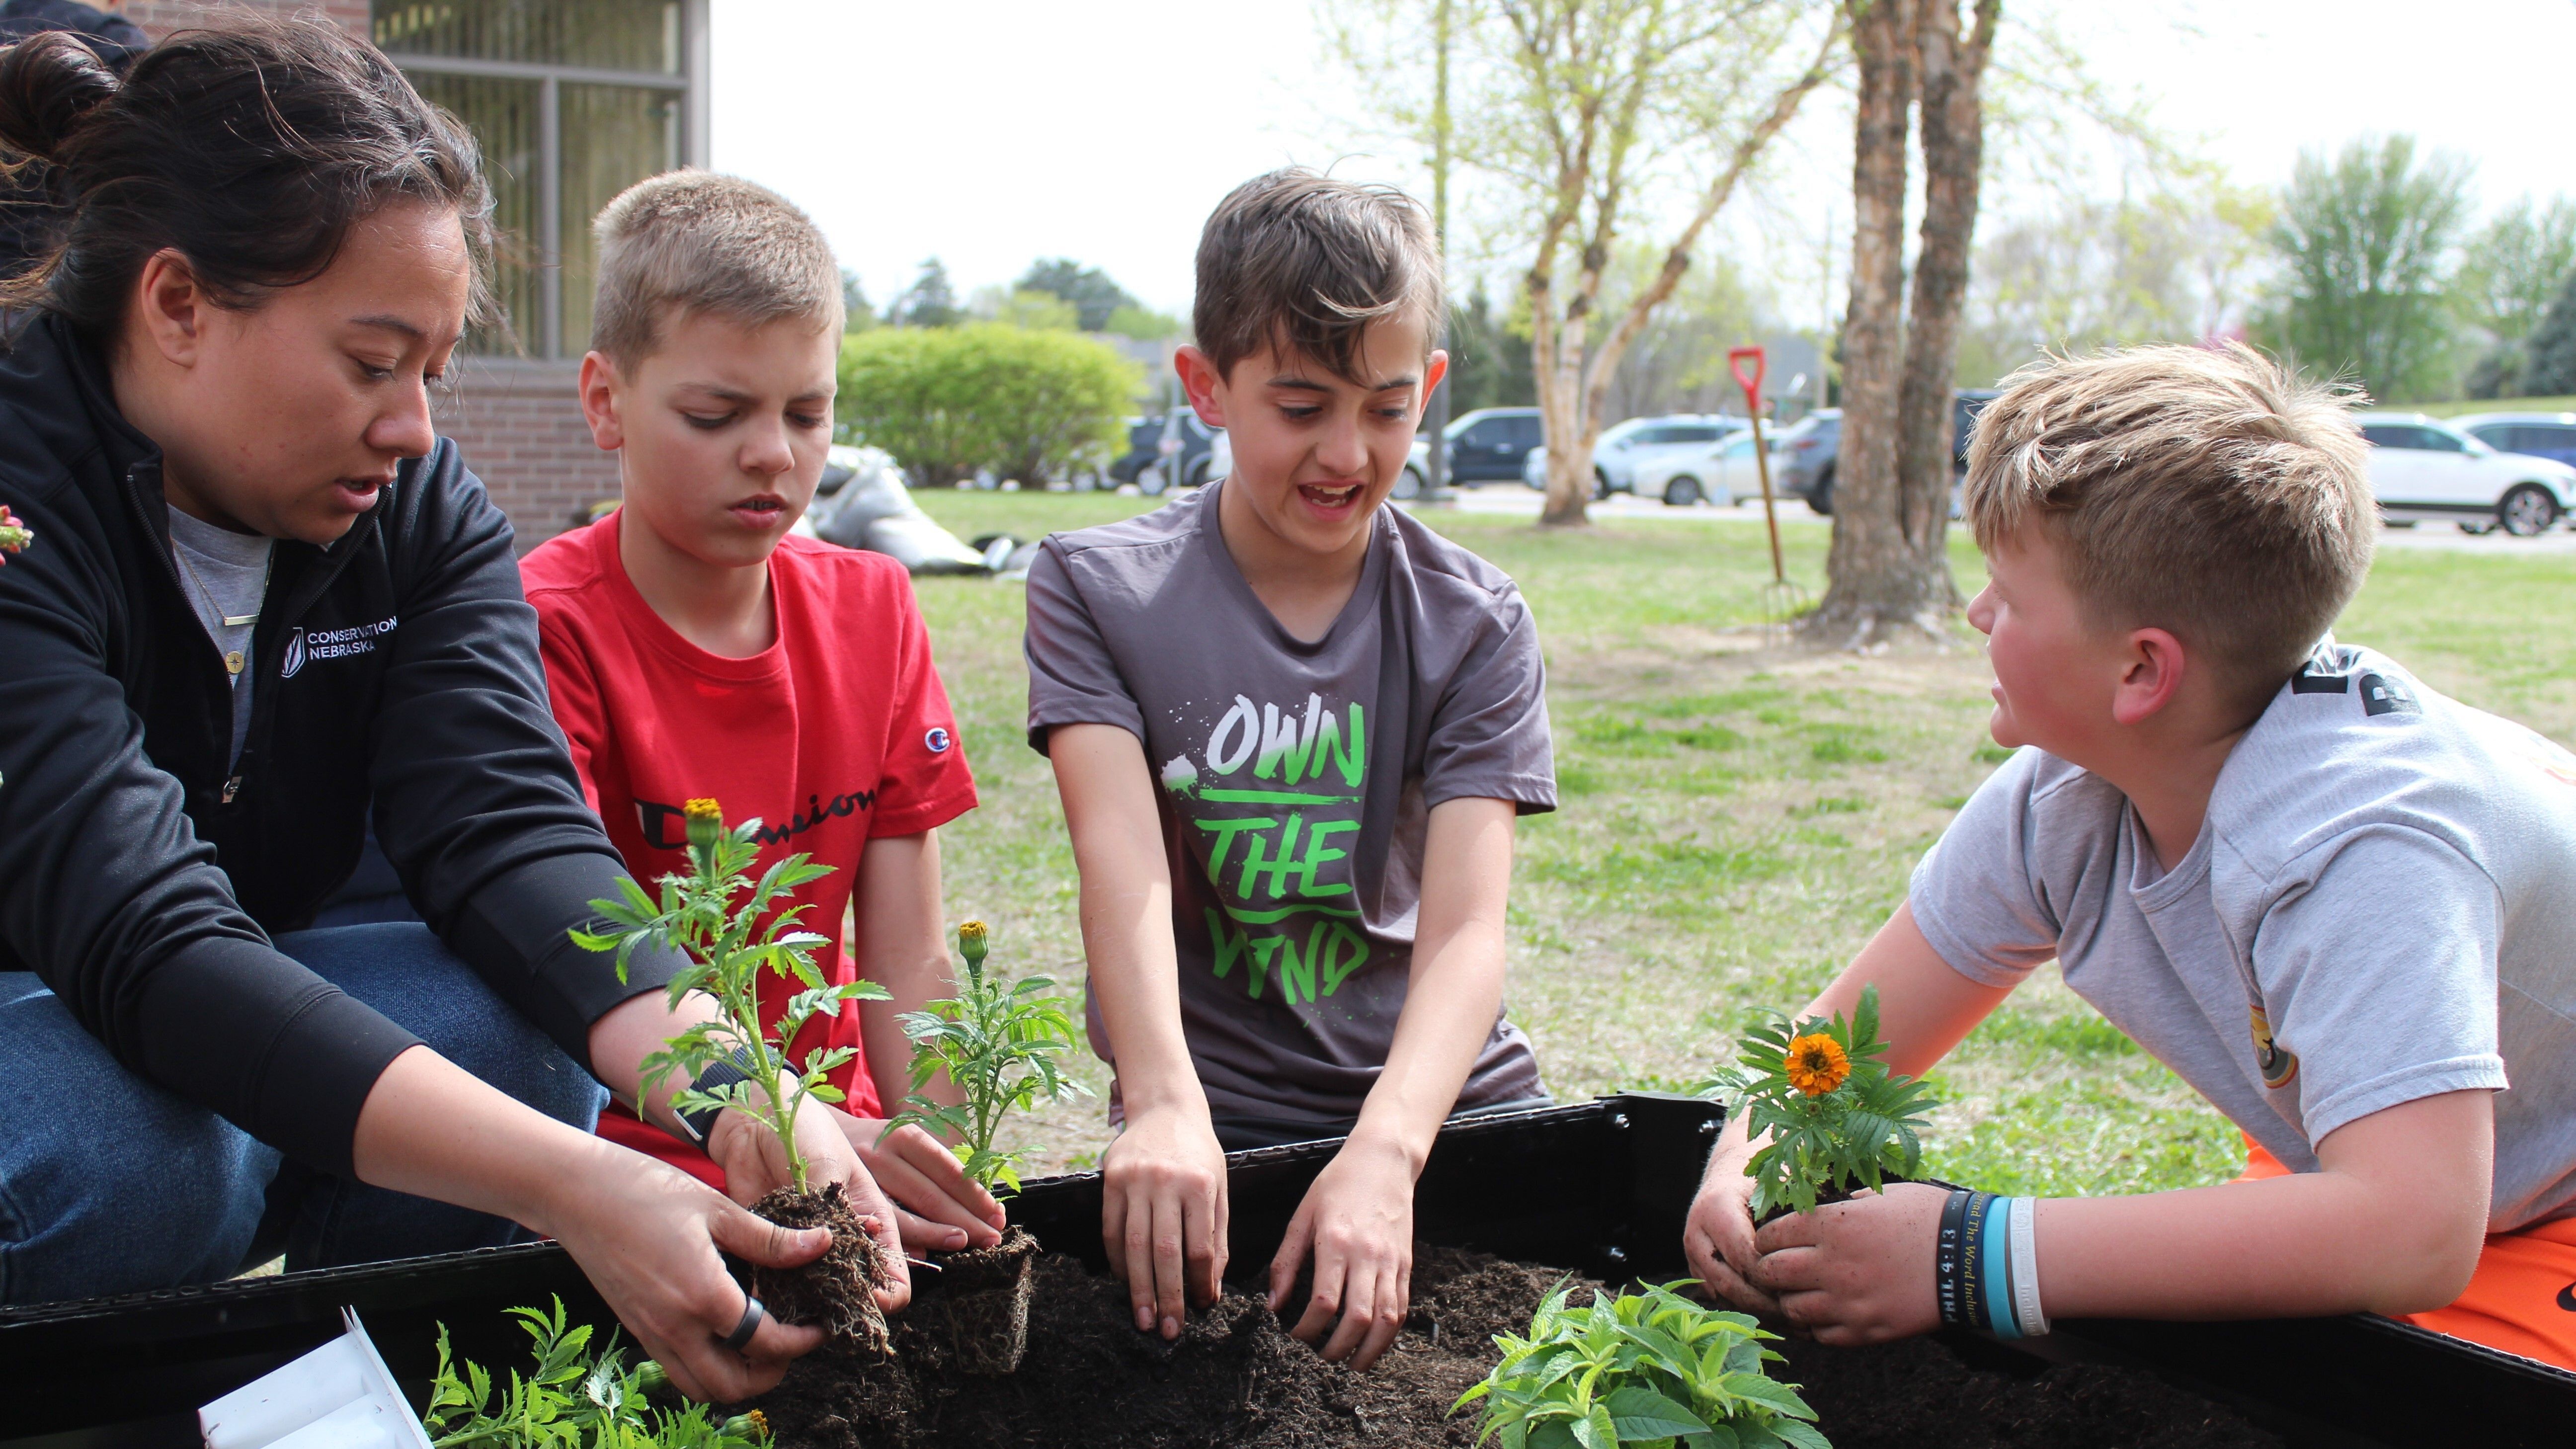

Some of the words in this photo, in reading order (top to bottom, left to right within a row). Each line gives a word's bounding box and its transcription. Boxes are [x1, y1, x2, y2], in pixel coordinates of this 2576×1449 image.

[308, 616, 397, 644] CONSERVATION
[310, 640, 376, 660] NEBRASKA
[1206, 692, 1366, 788] OWN
[1195, 812, 1362, 899] THE
[1204, 907, 1369, 1005] WIND
[1940, 1229, 1956, 1273] 4:13
[1966, 1220, 1980, 1242] The
[1963, 1245, 1976, 1279] Word
[1941, 1279, 1958, 1323] PHIL
